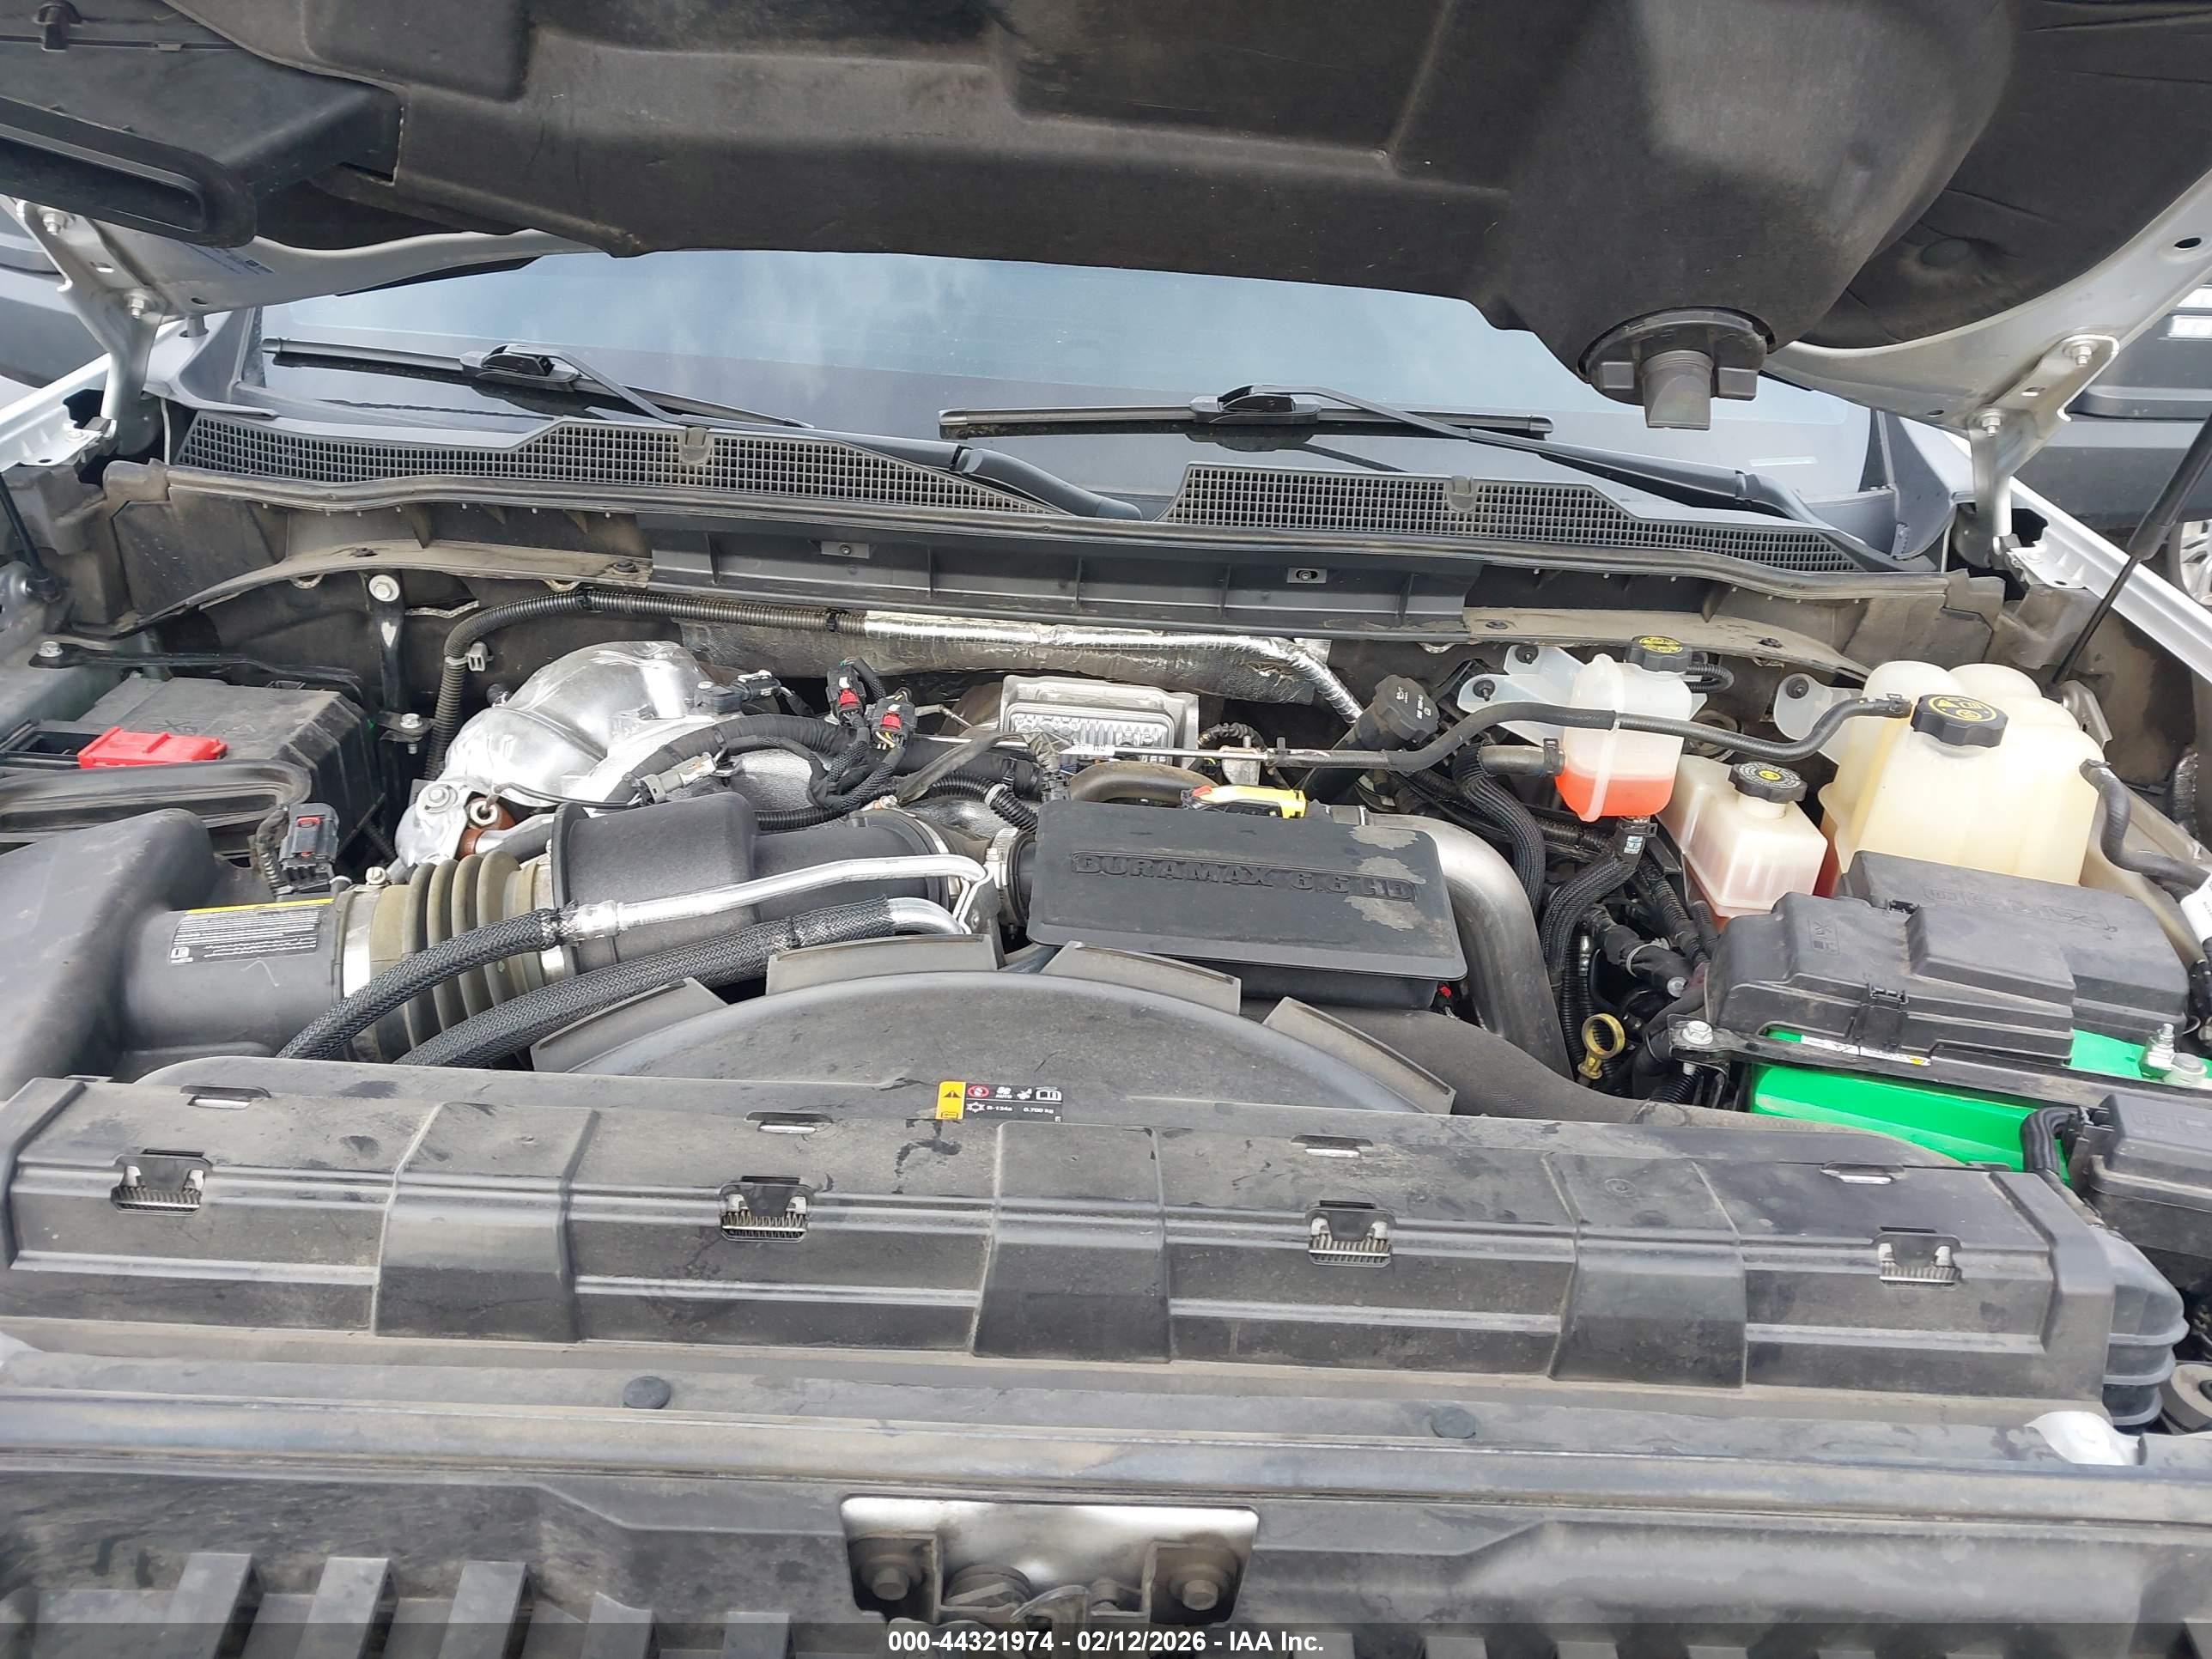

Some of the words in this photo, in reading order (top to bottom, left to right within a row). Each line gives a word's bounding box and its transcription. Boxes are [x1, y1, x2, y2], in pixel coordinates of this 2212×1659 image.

[1075, 855, 1274, 888] DURAMAX
[1291, 872, 1350, 894] 6.6
[1364, 878, 1413, 900] HD
